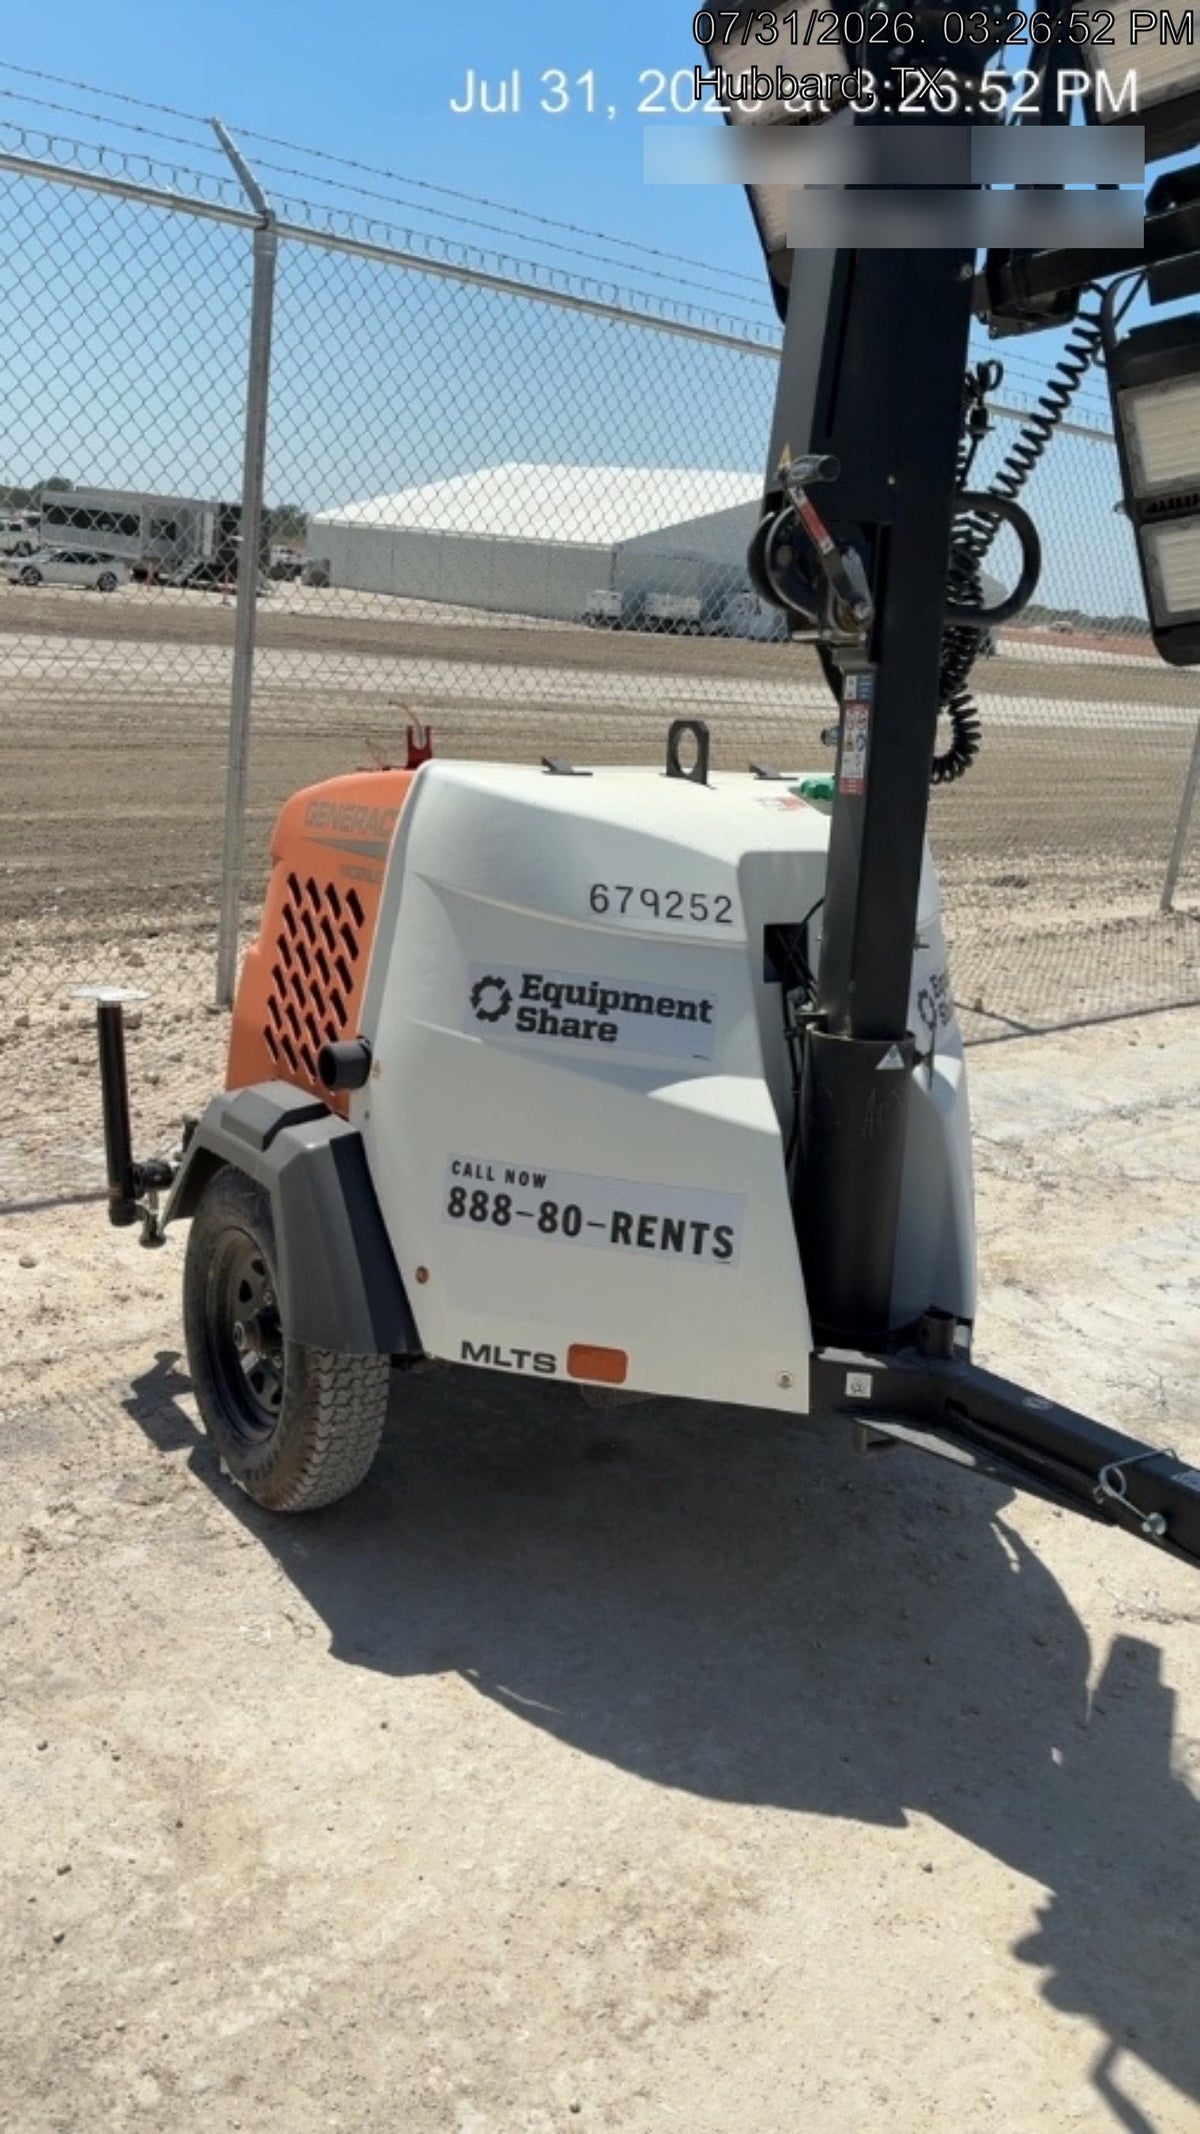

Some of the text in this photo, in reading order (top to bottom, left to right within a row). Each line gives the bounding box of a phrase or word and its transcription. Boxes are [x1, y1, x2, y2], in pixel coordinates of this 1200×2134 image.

[589, 883, 734, 924] 679252
[518, 973, 715, 1024] Equipment
[515, 1005, 619, 1043] Share
[451, 1159, 548, 1189] CALL NOW
[447, 1185, 735, 1260] 888-80-RENTS
[460, 1340, 557, 1374] MLTS
